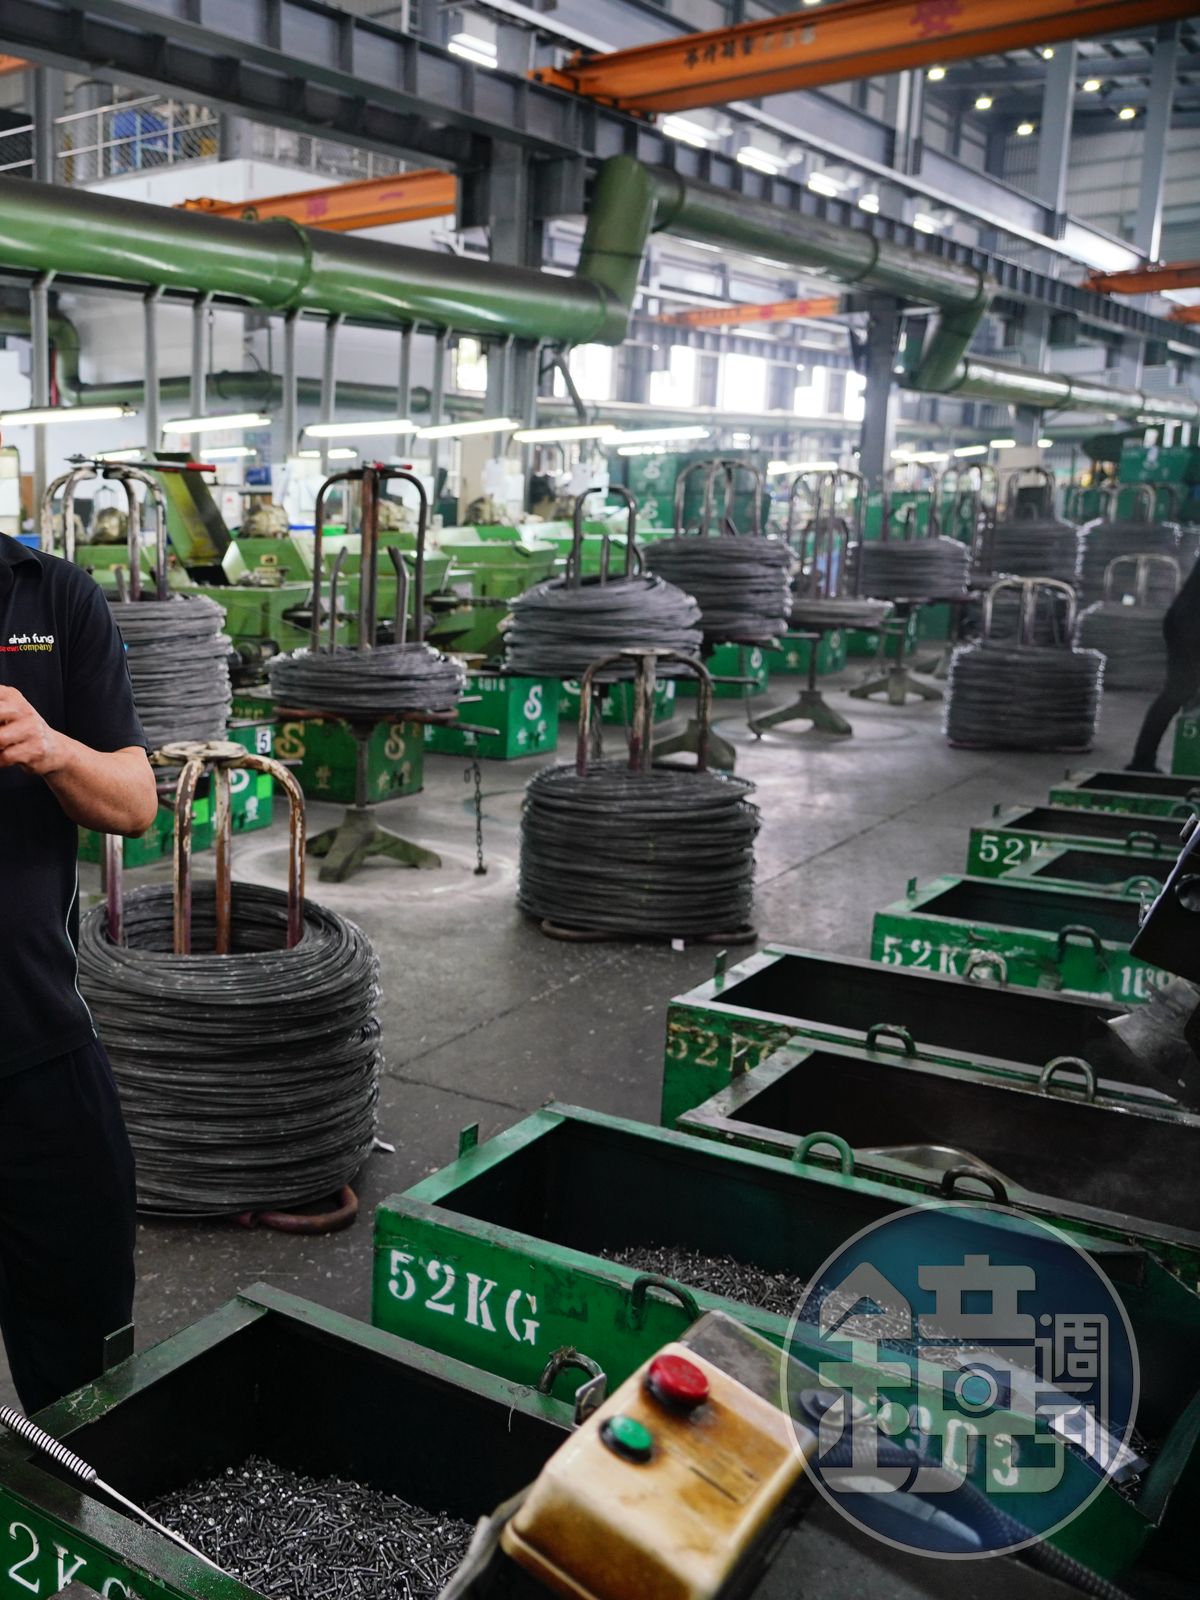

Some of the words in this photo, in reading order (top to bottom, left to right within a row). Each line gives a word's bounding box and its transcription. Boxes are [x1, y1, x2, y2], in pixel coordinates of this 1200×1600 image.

[32, 633, 54, 644] fung
[524, 685, 542, 720] S
[260, 733, 268, 750] 5
[388, 1249, 541, 1346] 52KG
